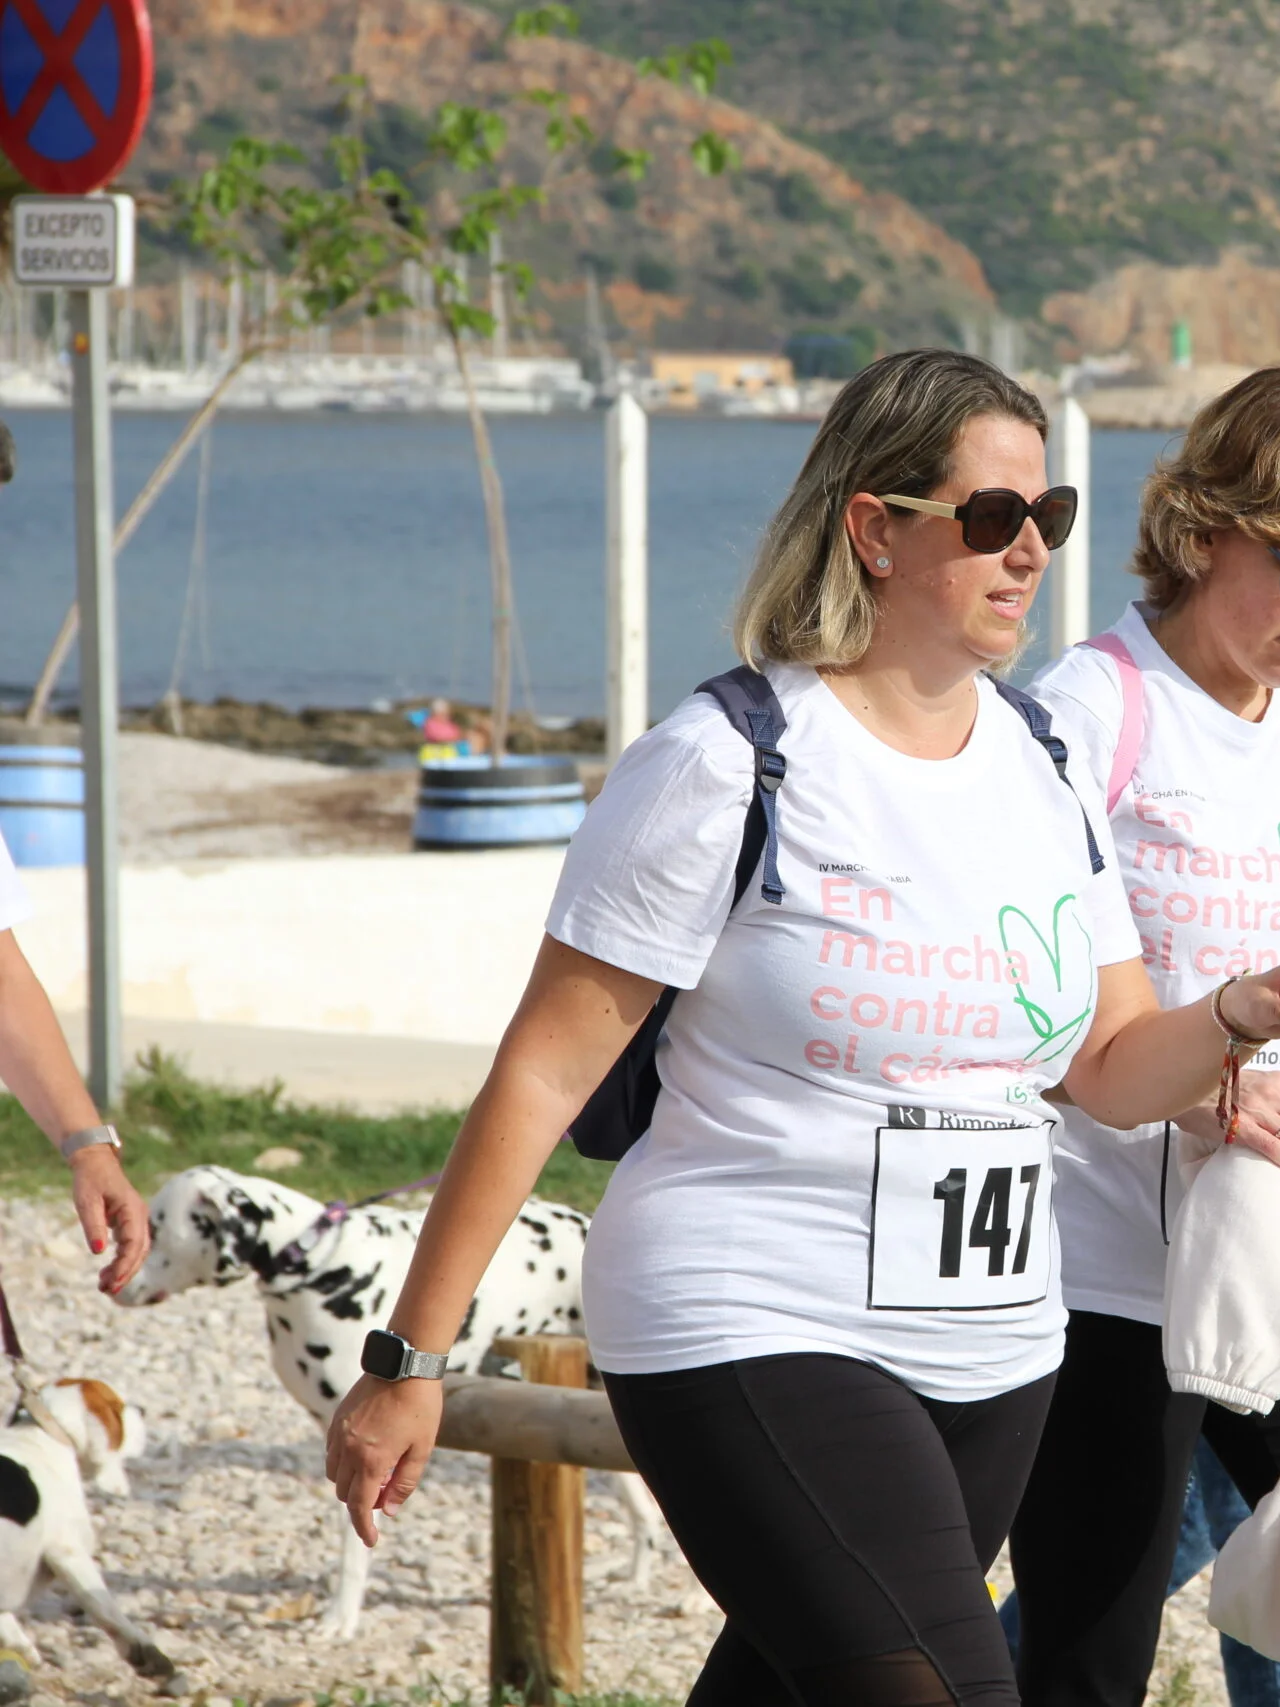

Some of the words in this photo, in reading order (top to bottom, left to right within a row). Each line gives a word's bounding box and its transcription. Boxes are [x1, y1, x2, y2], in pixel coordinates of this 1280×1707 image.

[25, 212, 104, 238] EXCEPTO
[21, 247, 109, 273] SERVICIOS
[819, 863, 829, 873] IV
[820, 876, 893, 921] En
[817, 929, 1030, 985] marcha
[810, 985, 1000, 1039] contra
[803, 1034, 861, 1074] el
[933, 1163, 1041, 1278] 147
